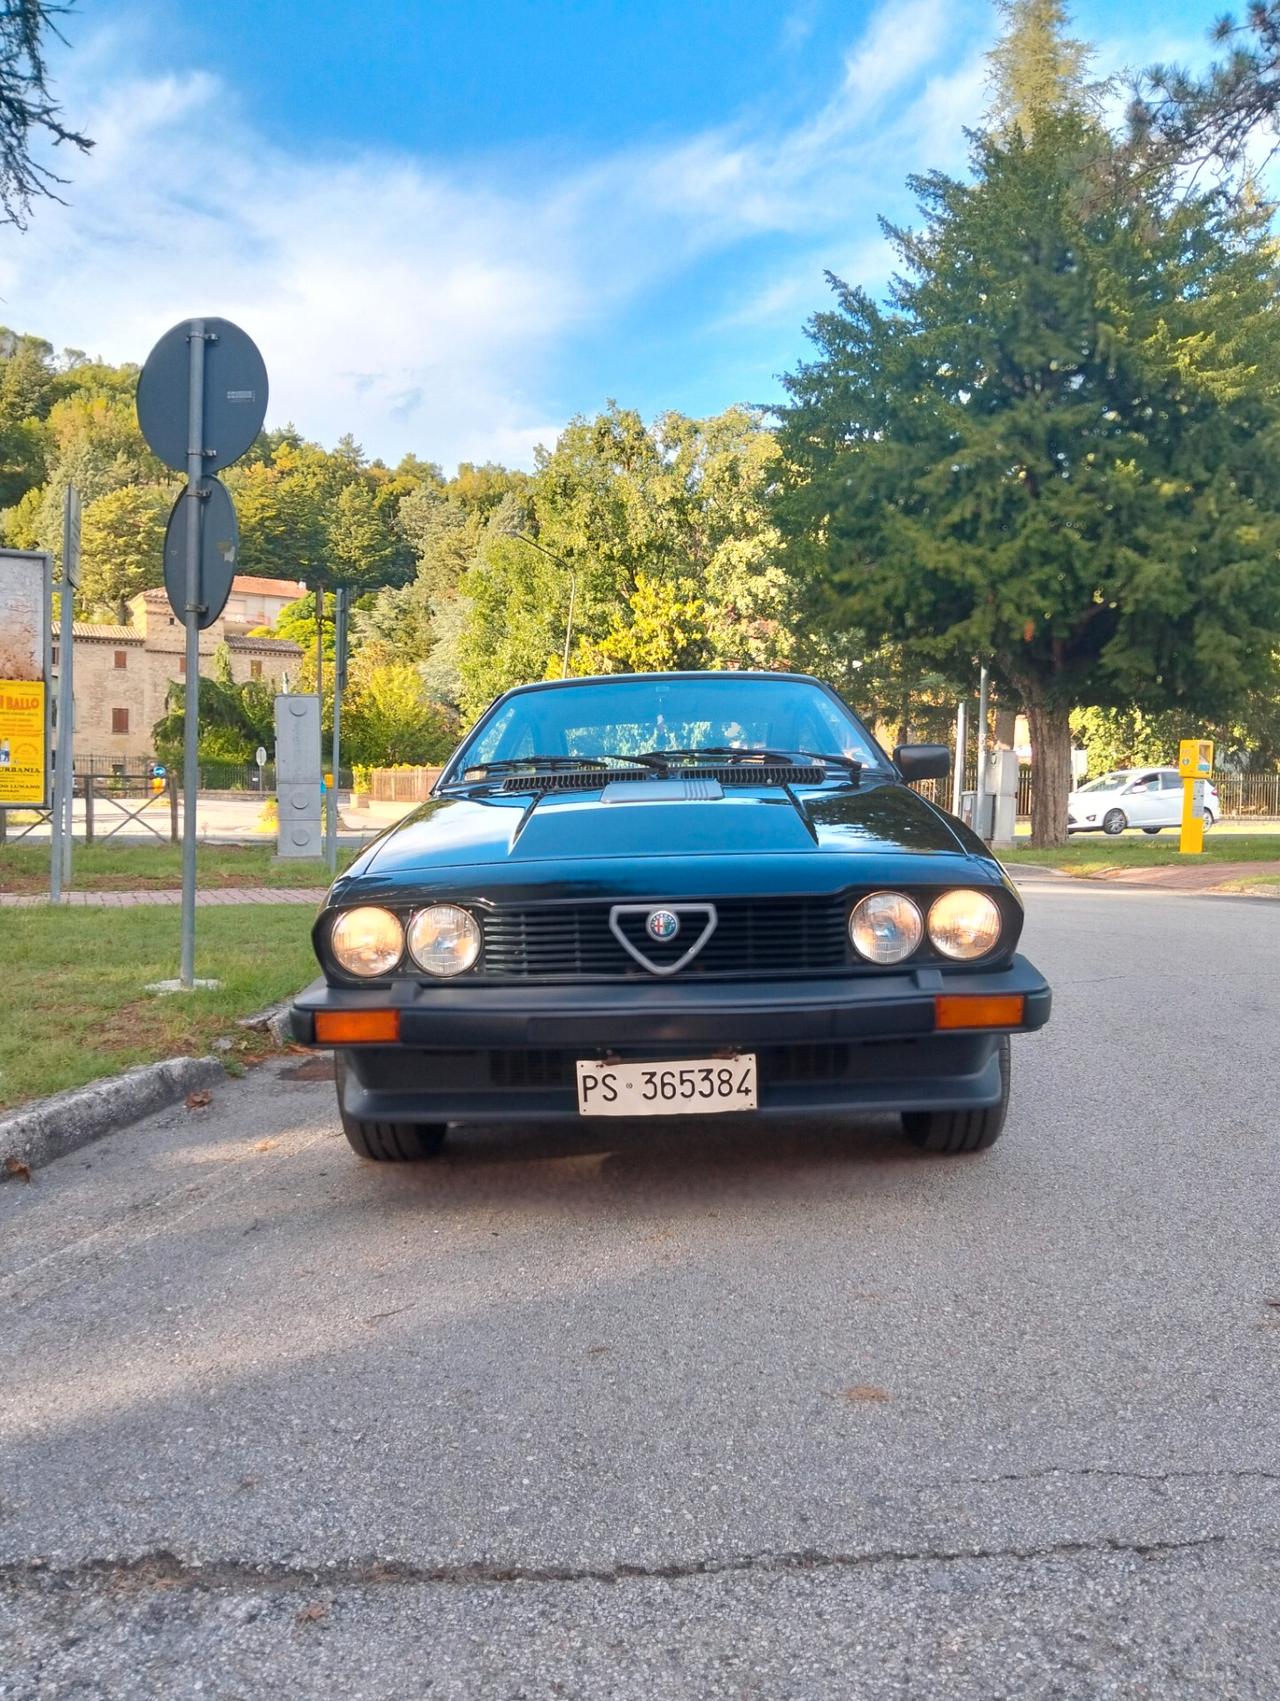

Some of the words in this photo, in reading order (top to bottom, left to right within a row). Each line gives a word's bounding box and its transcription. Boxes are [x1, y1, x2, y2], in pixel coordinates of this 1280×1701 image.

[6, 696, 39, 710] BALLO
[582, 1073, 618, 1102] PS
[641, 1068, 752, 1100] 365384
